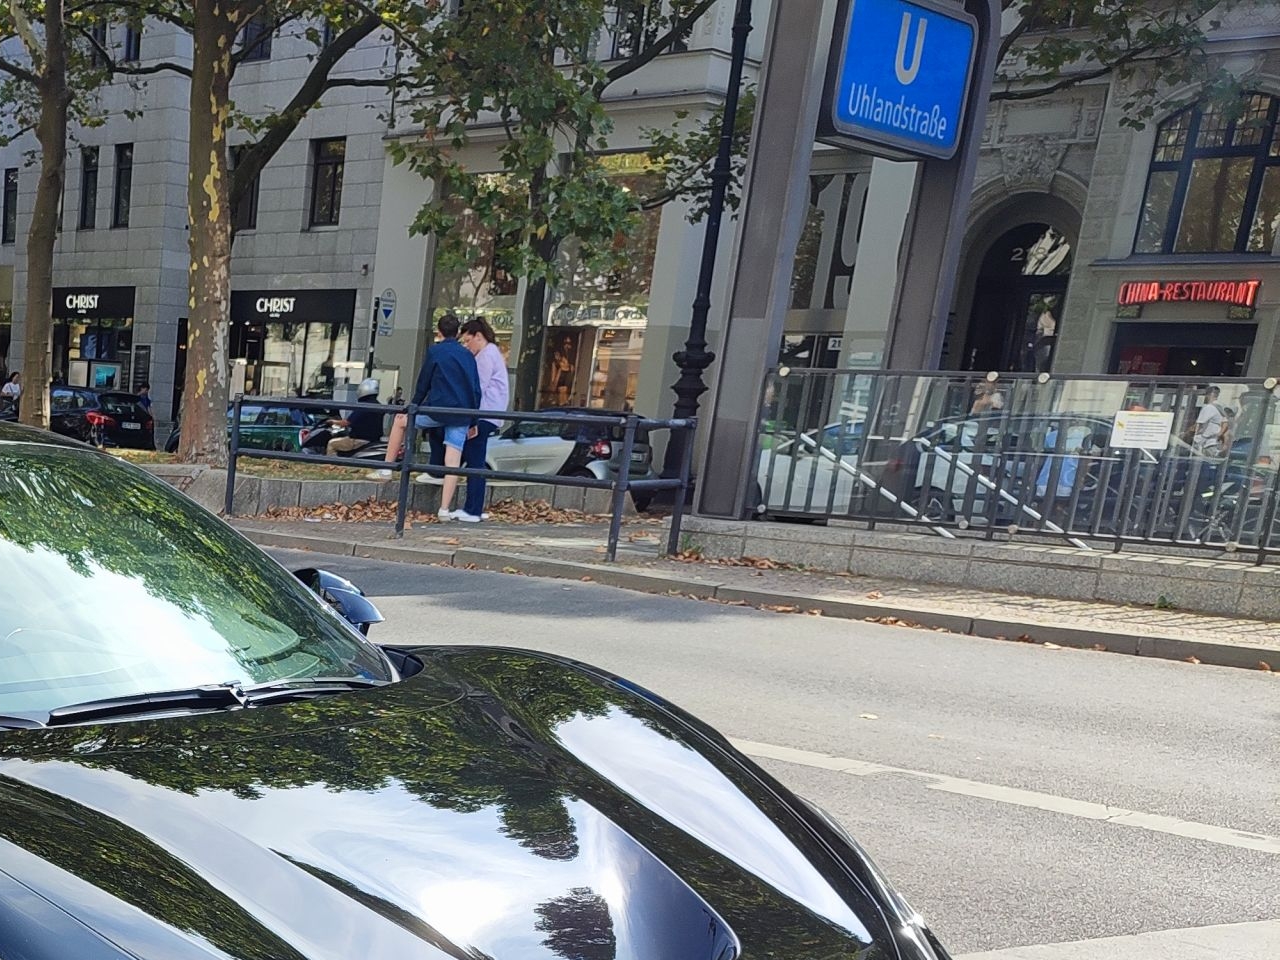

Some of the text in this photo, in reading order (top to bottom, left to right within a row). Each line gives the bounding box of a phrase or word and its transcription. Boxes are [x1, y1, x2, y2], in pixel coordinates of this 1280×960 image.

[895, 12, 928, 85] U
[848, 82, 947, 140] Uhlandstraße
[66, 294, 99, 309] CHRIST
[256, 297, 296, 312] CHRIST
[1119, 281, 1260, 305] CHINA-RESTAURANT
